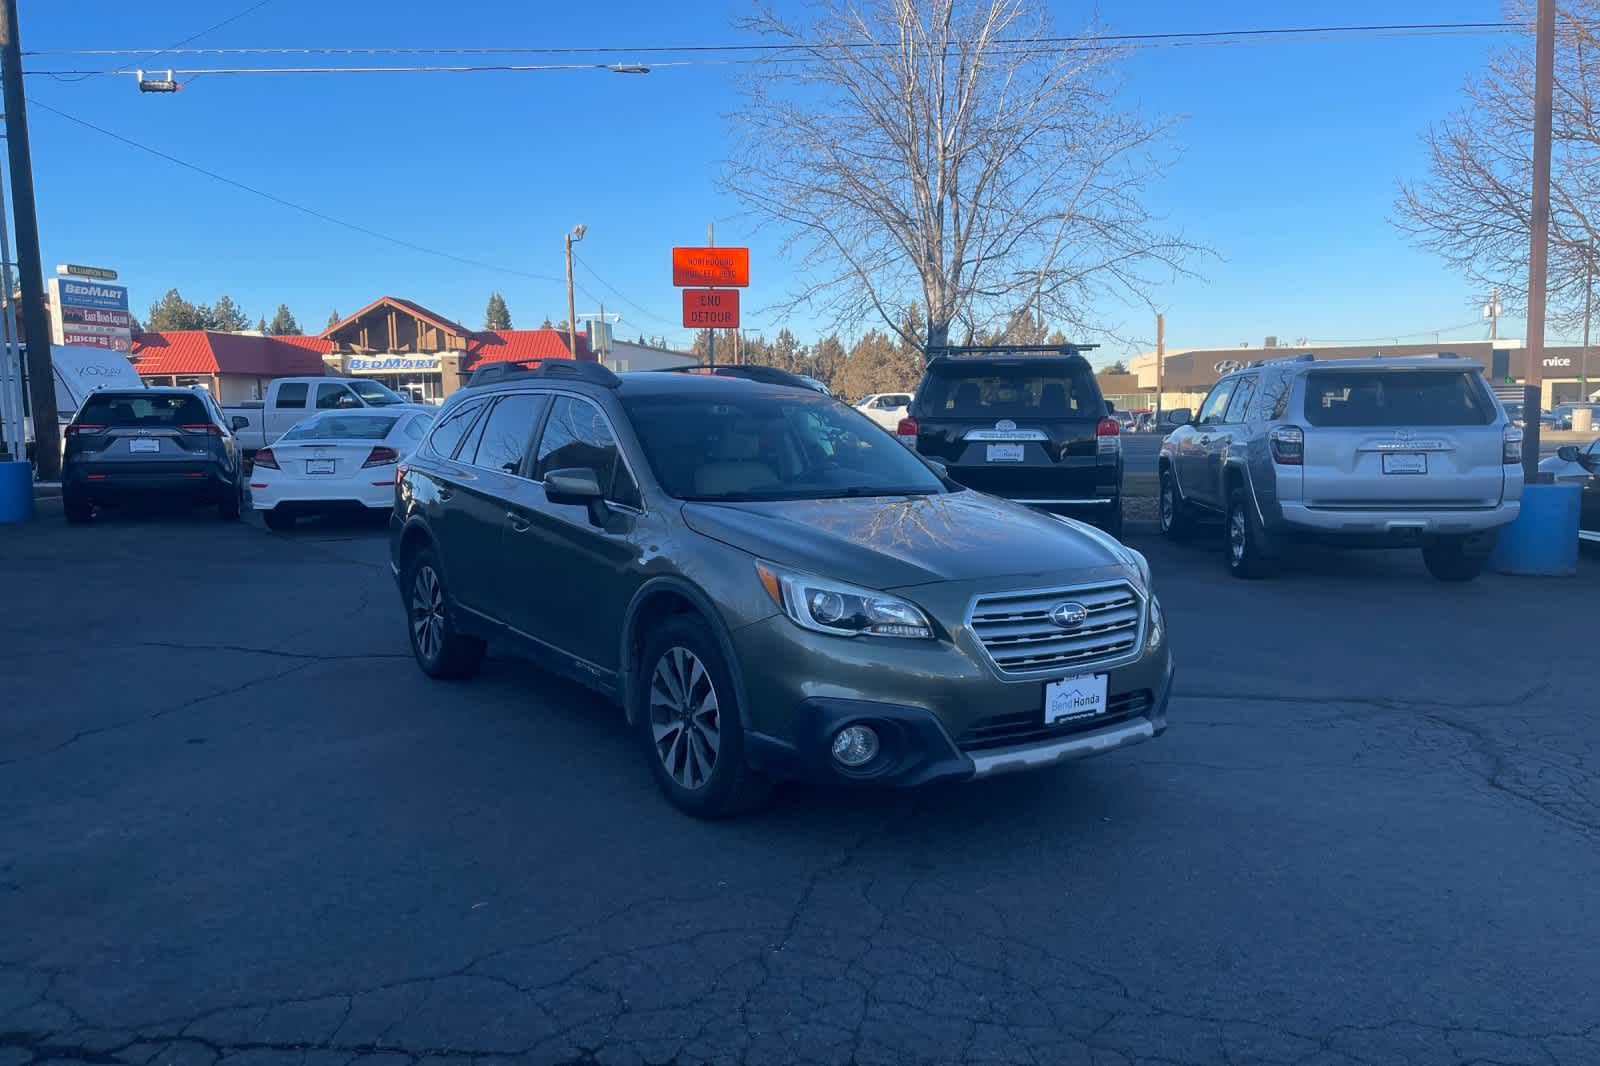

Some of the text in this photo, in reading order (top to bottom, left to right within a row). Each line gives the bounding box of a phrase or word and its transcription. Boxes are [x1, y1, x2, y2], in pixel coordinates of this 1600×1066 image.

[700, 295, 721, 306] END
[691, 311, 731, 323] DETOUR
[1543, 356, 1571, 367] rvice
[1051, 694, 1100, 712] Bend Honda
